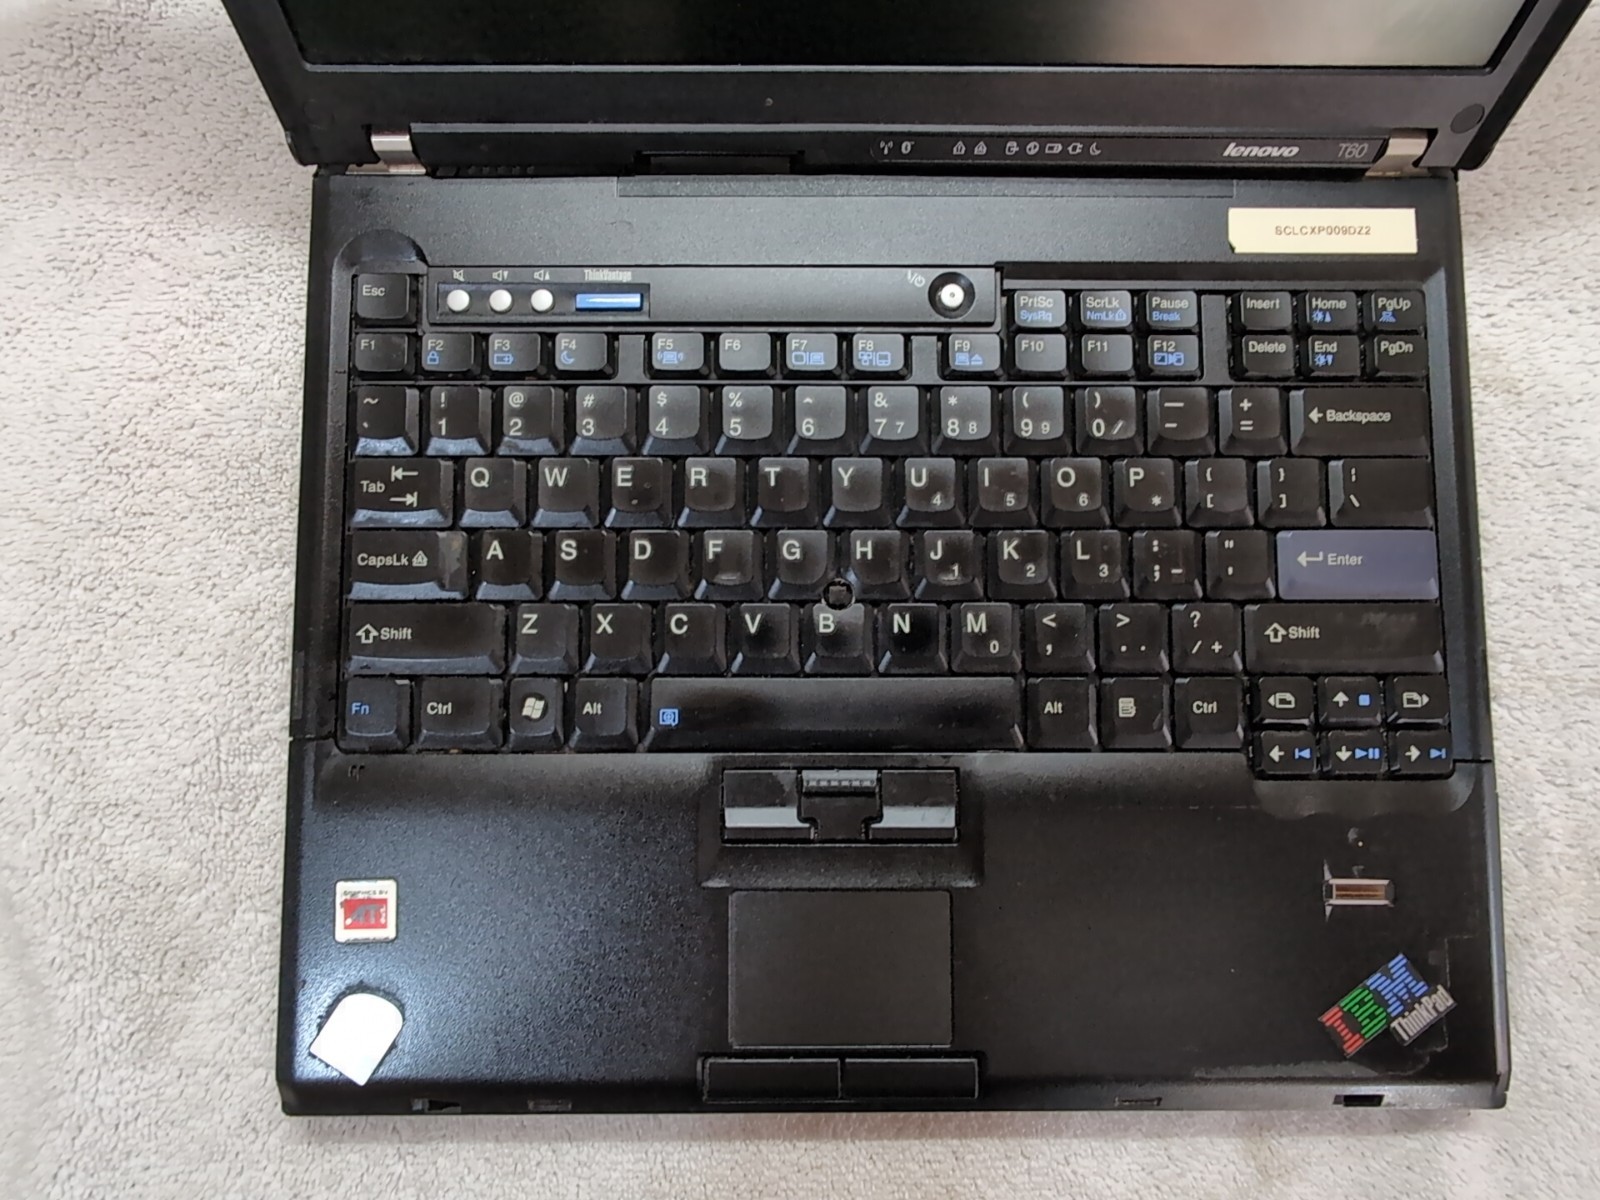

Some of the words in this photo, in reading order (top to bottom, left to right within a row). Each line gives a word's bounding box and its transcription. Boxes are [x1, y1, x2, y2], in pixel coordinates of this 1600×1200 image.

[1223, 142, 1300, 157] lenovo
[1337, 143, 1369, 158] T60
[583, 269, 632, 282] ThinkVantage
[362, 285, 386, 297] Esc
[1019, 296, 1054, 308] PrtSc
[1085, 296, 1120, 309] ScrLk
[1152, 297, 1189, 309] Pause
[1246, 298, 1280, 309] Insert
[1311, 298, 1347, 309] Home
[1378, 297, 1411, 312] PgUp
[1019, 310, 1053, 323] SysRq
[1086, 311, 1115, 321] NmLk
[1152, 311, 1181, 322] Break
[360, 340, 375, 351] F1
[427, 340, 444, 351] F2
[494, 340, 511, 351] F3
[561, 340, 577, 351] F4
[657, 340, 674, 351] F5
[724, 340, 741, 351] F6
[791, 340, 808, 351] F7
[858, 340, 874, 351] F8
[954, 340, 971, 351] F9
[1021, 341, 1044, 351] F10
[1087, 341, 1108, 351] F11
[1153, 341, 1176, 352] F12
[1248, 341, 1287, 353] Delete
[1314, 341, 1338, 353] End
[1380, 341, 1413, 356] PgDn
[508, 393, 525, 408] @
[582, 393, 595, 408] #
[656, 391, 668, 407] $
[728, 392, 743, 408] %
[874, 392, 889, 408] &
[1326, 409, 1392, 424] Backspace
[438, 418, 447, 436] 1
[508, 418, 523, 436] 2
[581, 418, 595, 436] 3
[655, 418, 669, 436] 4
[728, 418, 743, 436] 5
[801, 418, 815, 436] 6
[874, 418, 887, 436] 7
[895, 421, 905, 434] 7
[947, 418, 960, 436] 8
[968, 421, 978, 435] 8
[1020, 418, 1033, 437] 9
[1040, 421, 1050, 435] 9
[1092, 418, 1105, 437] 0
[470, 467, 490, 488] Q
[544, 467, 568, 488] W
[616, 467, 633, 488] E
[690, 467, 708, 488] R
[764, 467, 781, 488] T
[837, 467, 854, 488] Y
[910, 467, 927, 488] U
[984, 467, 990, 488] I
[1056, 467, 1076, 488] O
[1128, 467, 1145, 488] P
[360, 481, 385, 493] Tab
[931, 493, 942, 507] 4
[1005, 493, 1016, 507] 5
[1078, 493, 1089, 507] 6
[486, 540, 504, 560] A
[560, 540, 578, 560] S
[633, 540, 652, 560] D
[707, 540, 723, 560] F
[782, 540, 801, 560] G
[855, 540, 873, 560] H
[929, 540, 943, 560] J
[1003, 540, 1021, 560] K
[1075, 540, 1090, 560] L
[357, 553, 409, 568] CapsLk
[1327, 553, 1363, 566] Enter
[951, 564, 959, 578] 1
[1025, 564, 1036, 578] 2
[1098, 564, 1109, 578] 3
[521, 613, 539, 634] Z
[595, 613, 614, 634] X
[669, 613, 689, 634] C
[744, 613, 763, 634] V
[818, 613, 836, 634] B
[892, 613, 911, 634] N
[966, 613, 988, 634] M
[1189, 611, 1201, 628] ?
[380, 627, 412, 641] Shift
[1288, 626, 1321, 639] Shift
[989, 640, 1000, 654] 0
[351, 702, 370, 715] Fn
[426, 702, 452, 715] Ctrl
[582, 702, 602, 715] Alt
[1044, 701, 1063, 714] Alt
[1192, 701, 1218, 714] Ctrl
[1321, 952, 1429, 1054] IBM
[1389, 984, 1455, 1041] ThinkPad
